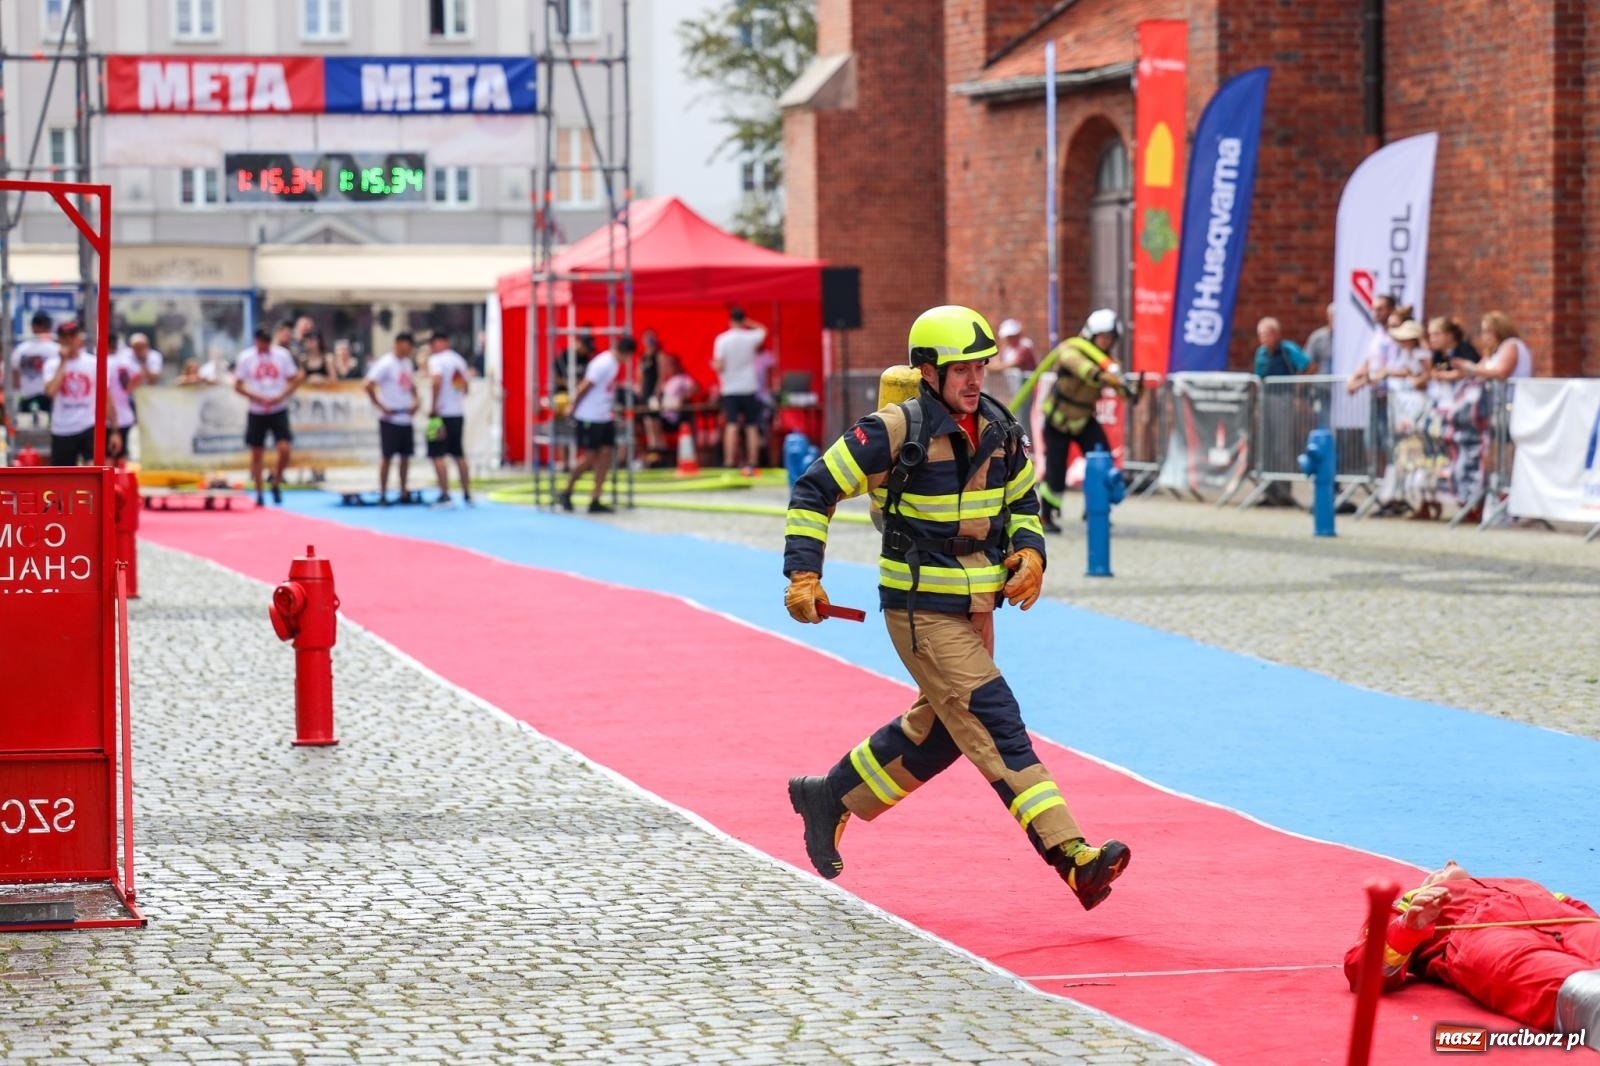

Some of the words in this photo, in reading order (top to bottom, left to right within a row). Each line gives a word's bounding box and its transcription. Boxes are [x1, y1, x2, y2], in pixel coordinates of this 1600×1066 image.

[138, 62, 292, 111] META
[361, 64, 512, 111] META
[1192, 137, 1242, 310] Husqvarna
